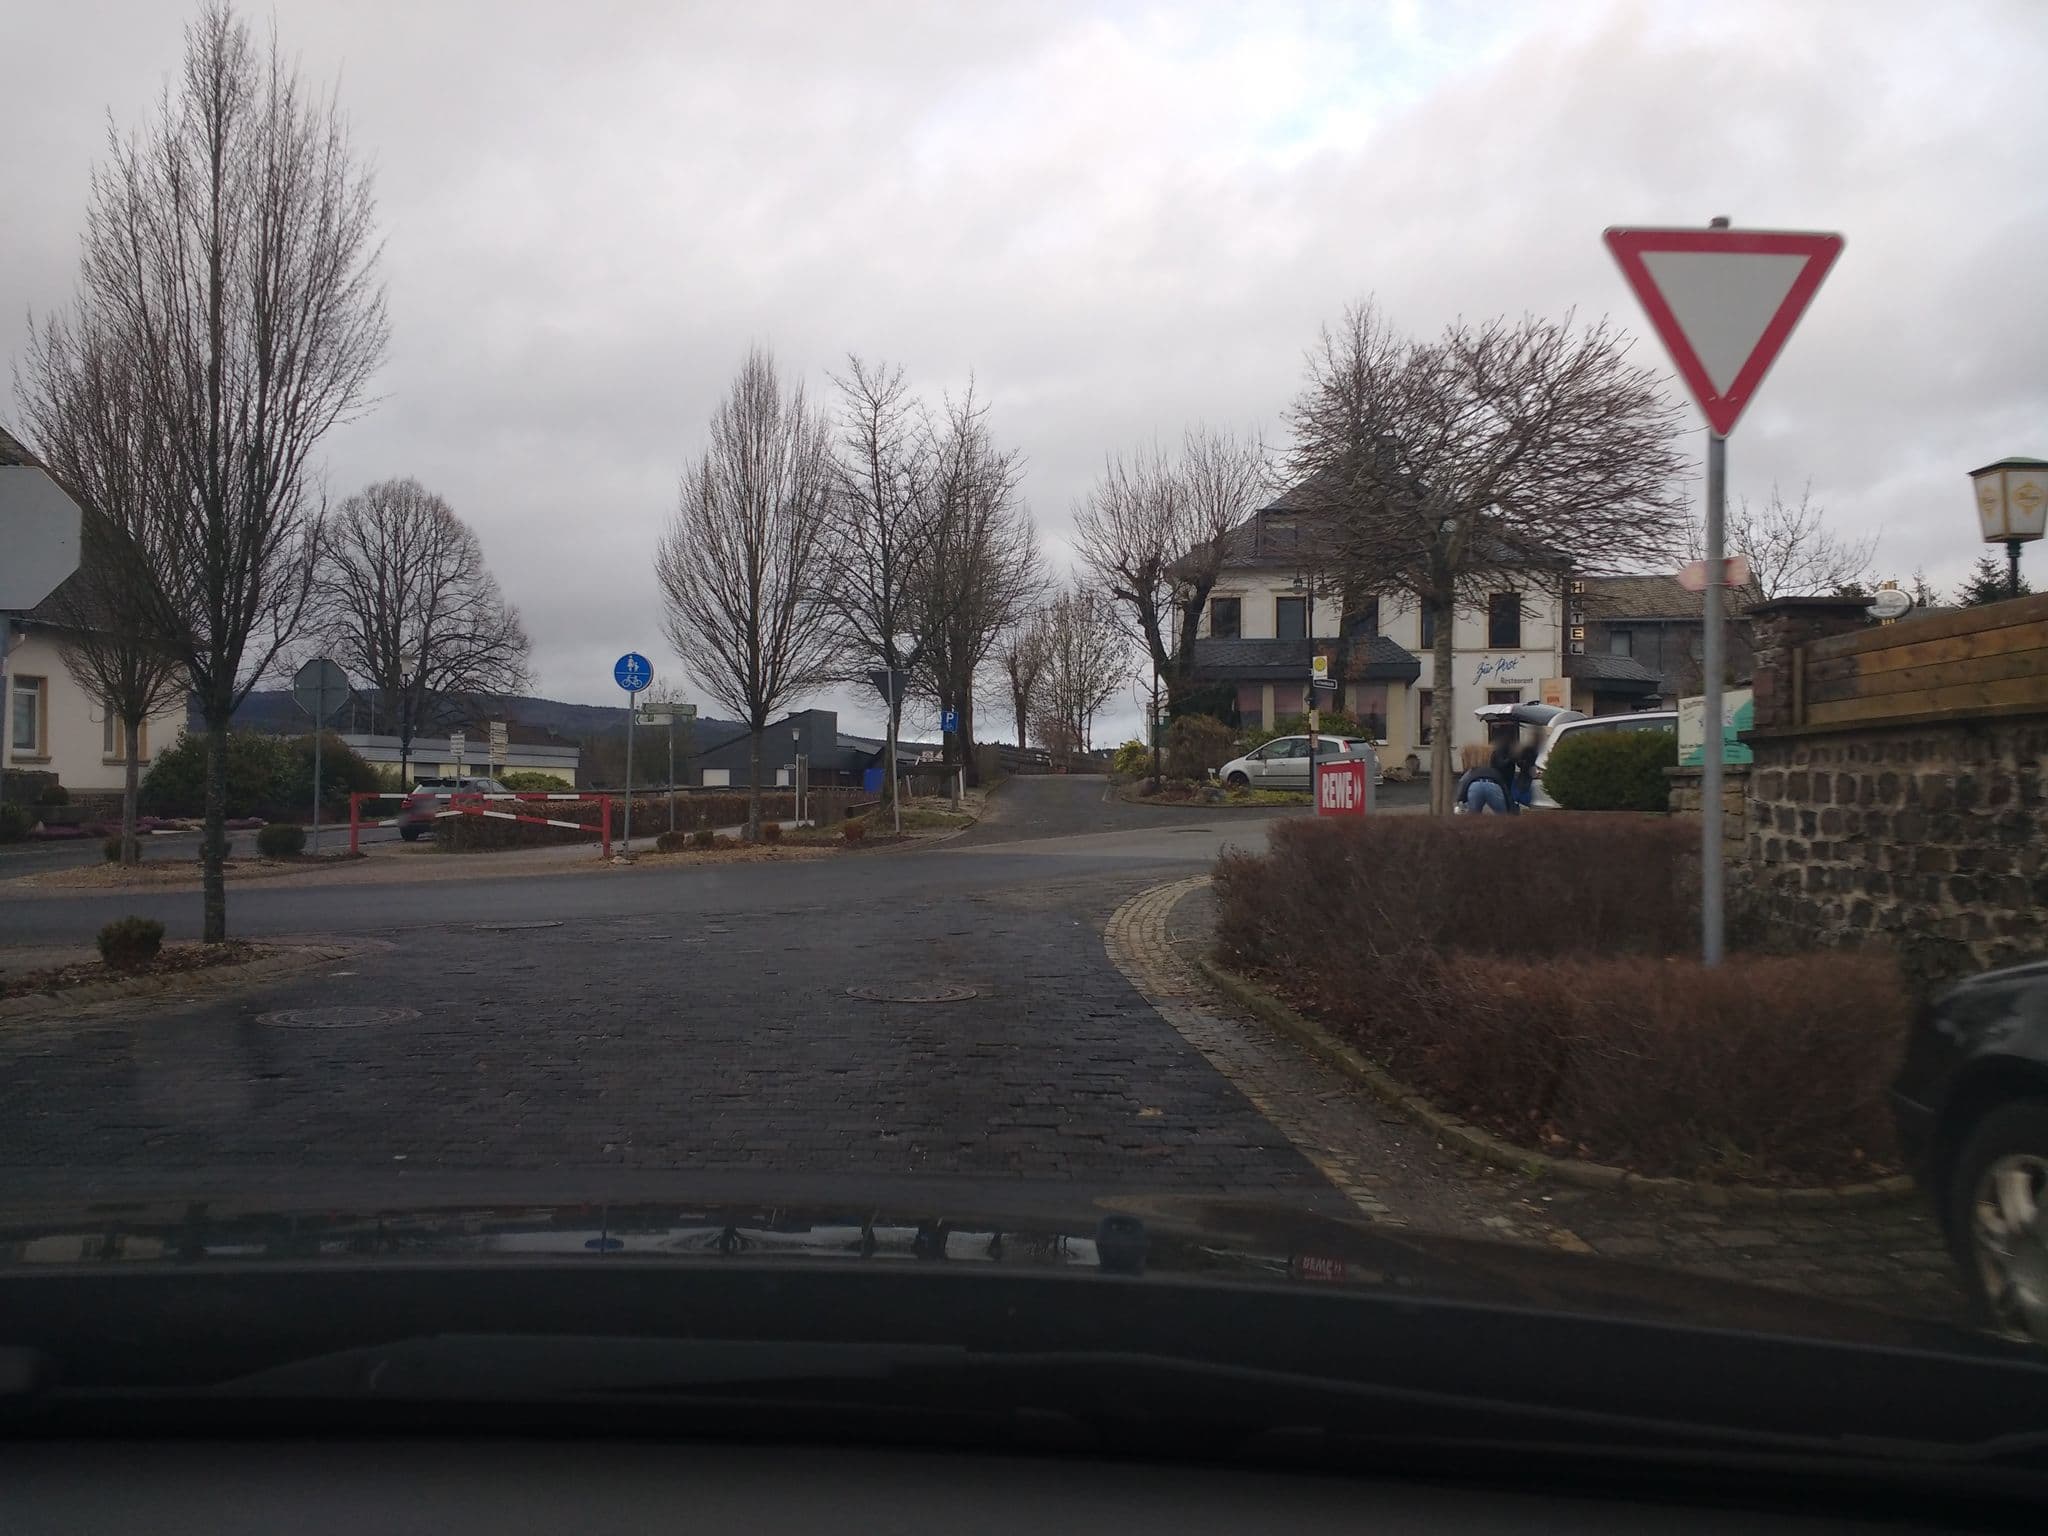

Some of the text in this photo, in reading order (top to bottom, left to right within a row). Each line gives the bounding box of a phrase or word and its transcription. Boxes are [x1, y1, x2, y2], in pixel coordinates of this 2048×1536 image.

[1495, 658, 1519, 679] Post
[946, 712, 954, 723] P
[1322, 771, 1353, 809] REWE
